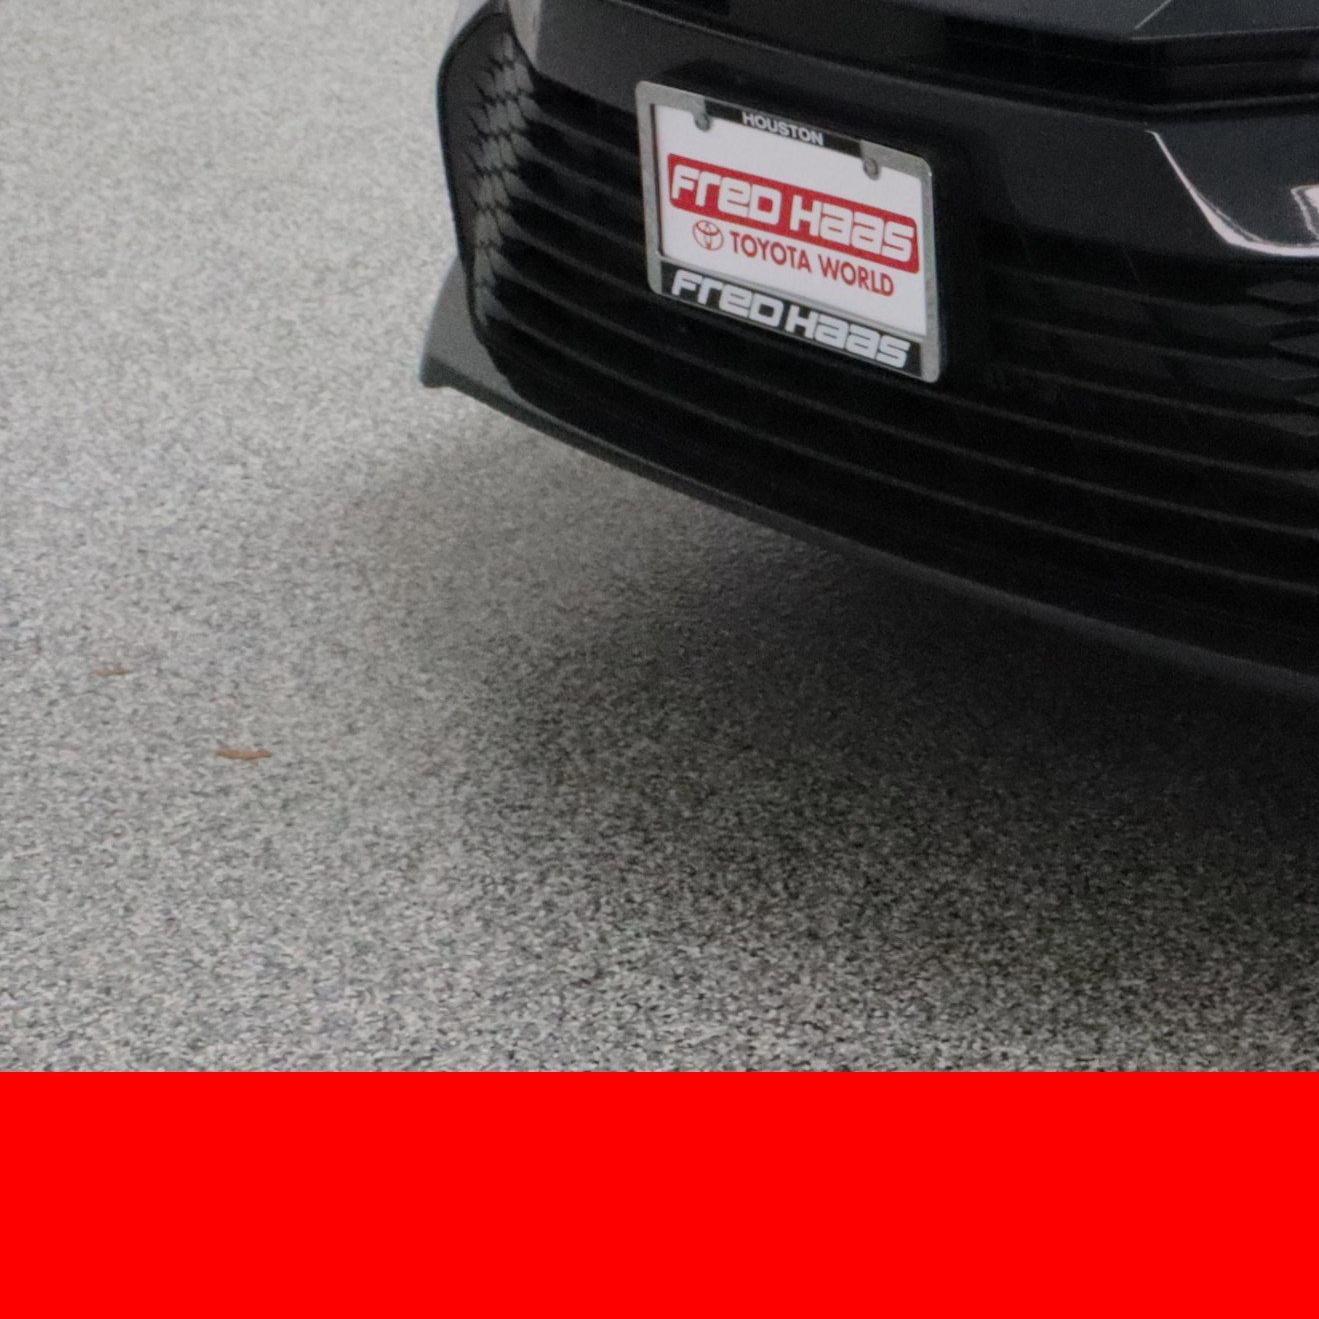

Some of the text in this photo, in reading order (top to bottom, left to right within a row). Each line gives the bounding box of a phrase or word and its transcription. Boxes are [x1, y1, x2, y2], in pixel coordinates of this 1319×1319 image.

[742, 112, 824, 146] HOUSTON
[730, 232, 894, 297] TOYOTA WORLD
